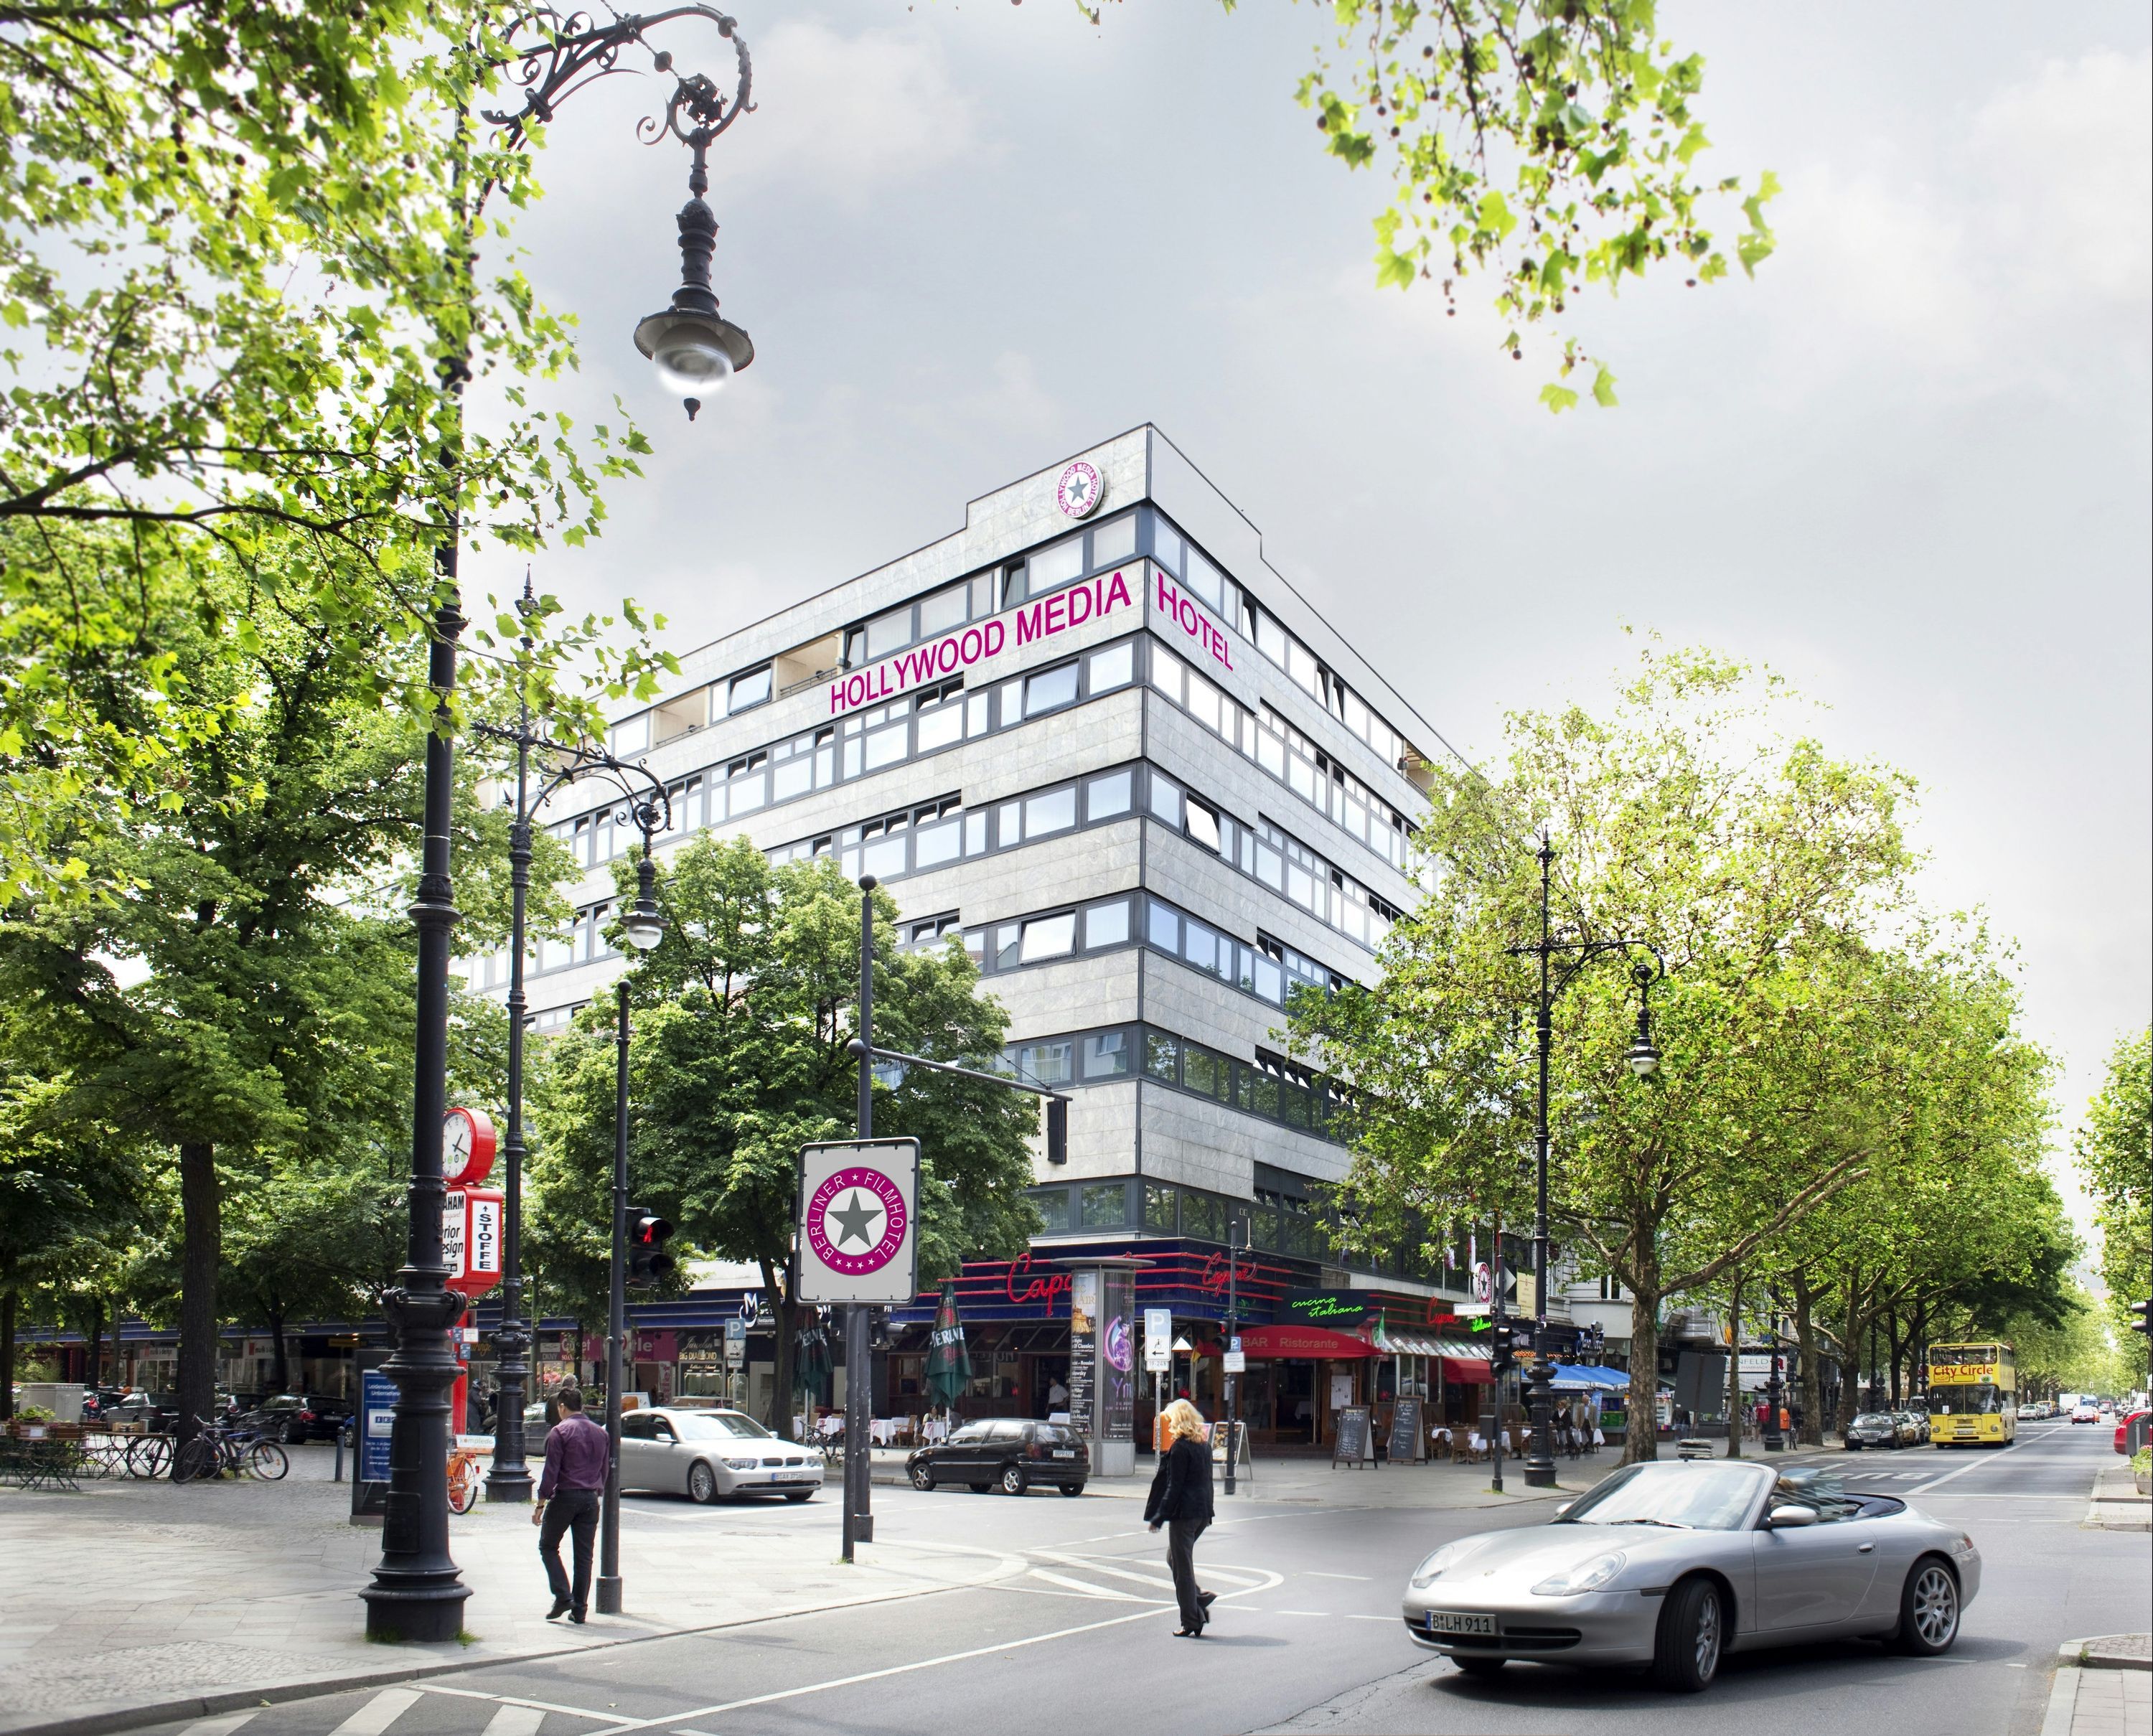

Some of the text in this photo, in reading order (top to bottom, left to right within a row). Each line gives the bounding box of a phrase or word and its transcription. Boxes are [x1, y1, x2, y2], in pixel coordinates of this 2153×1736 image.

[1059, 463, 1098, 512] HOLLYWOOD MEDIA HOTEL
[1066, 502, 1089, 517] BERLIN
[831, 571, 1233, 714] HOLLYWOOD MEDIA HOTEL
[810, 1171, 904, 1261] BERLINER FILMHOTEL
[478, 1214, 492, 1270] STOFFE
[1292, 1297, 1337, 1308] cucina
[1308, 1303, 1364, 1318] italiana
[1243, 1338, 1338, 1348] BAR Ristorante
[1934, 1364, 1994, 1378] City Circle
[1432, 1614, 1491, 1633] B LH 911
